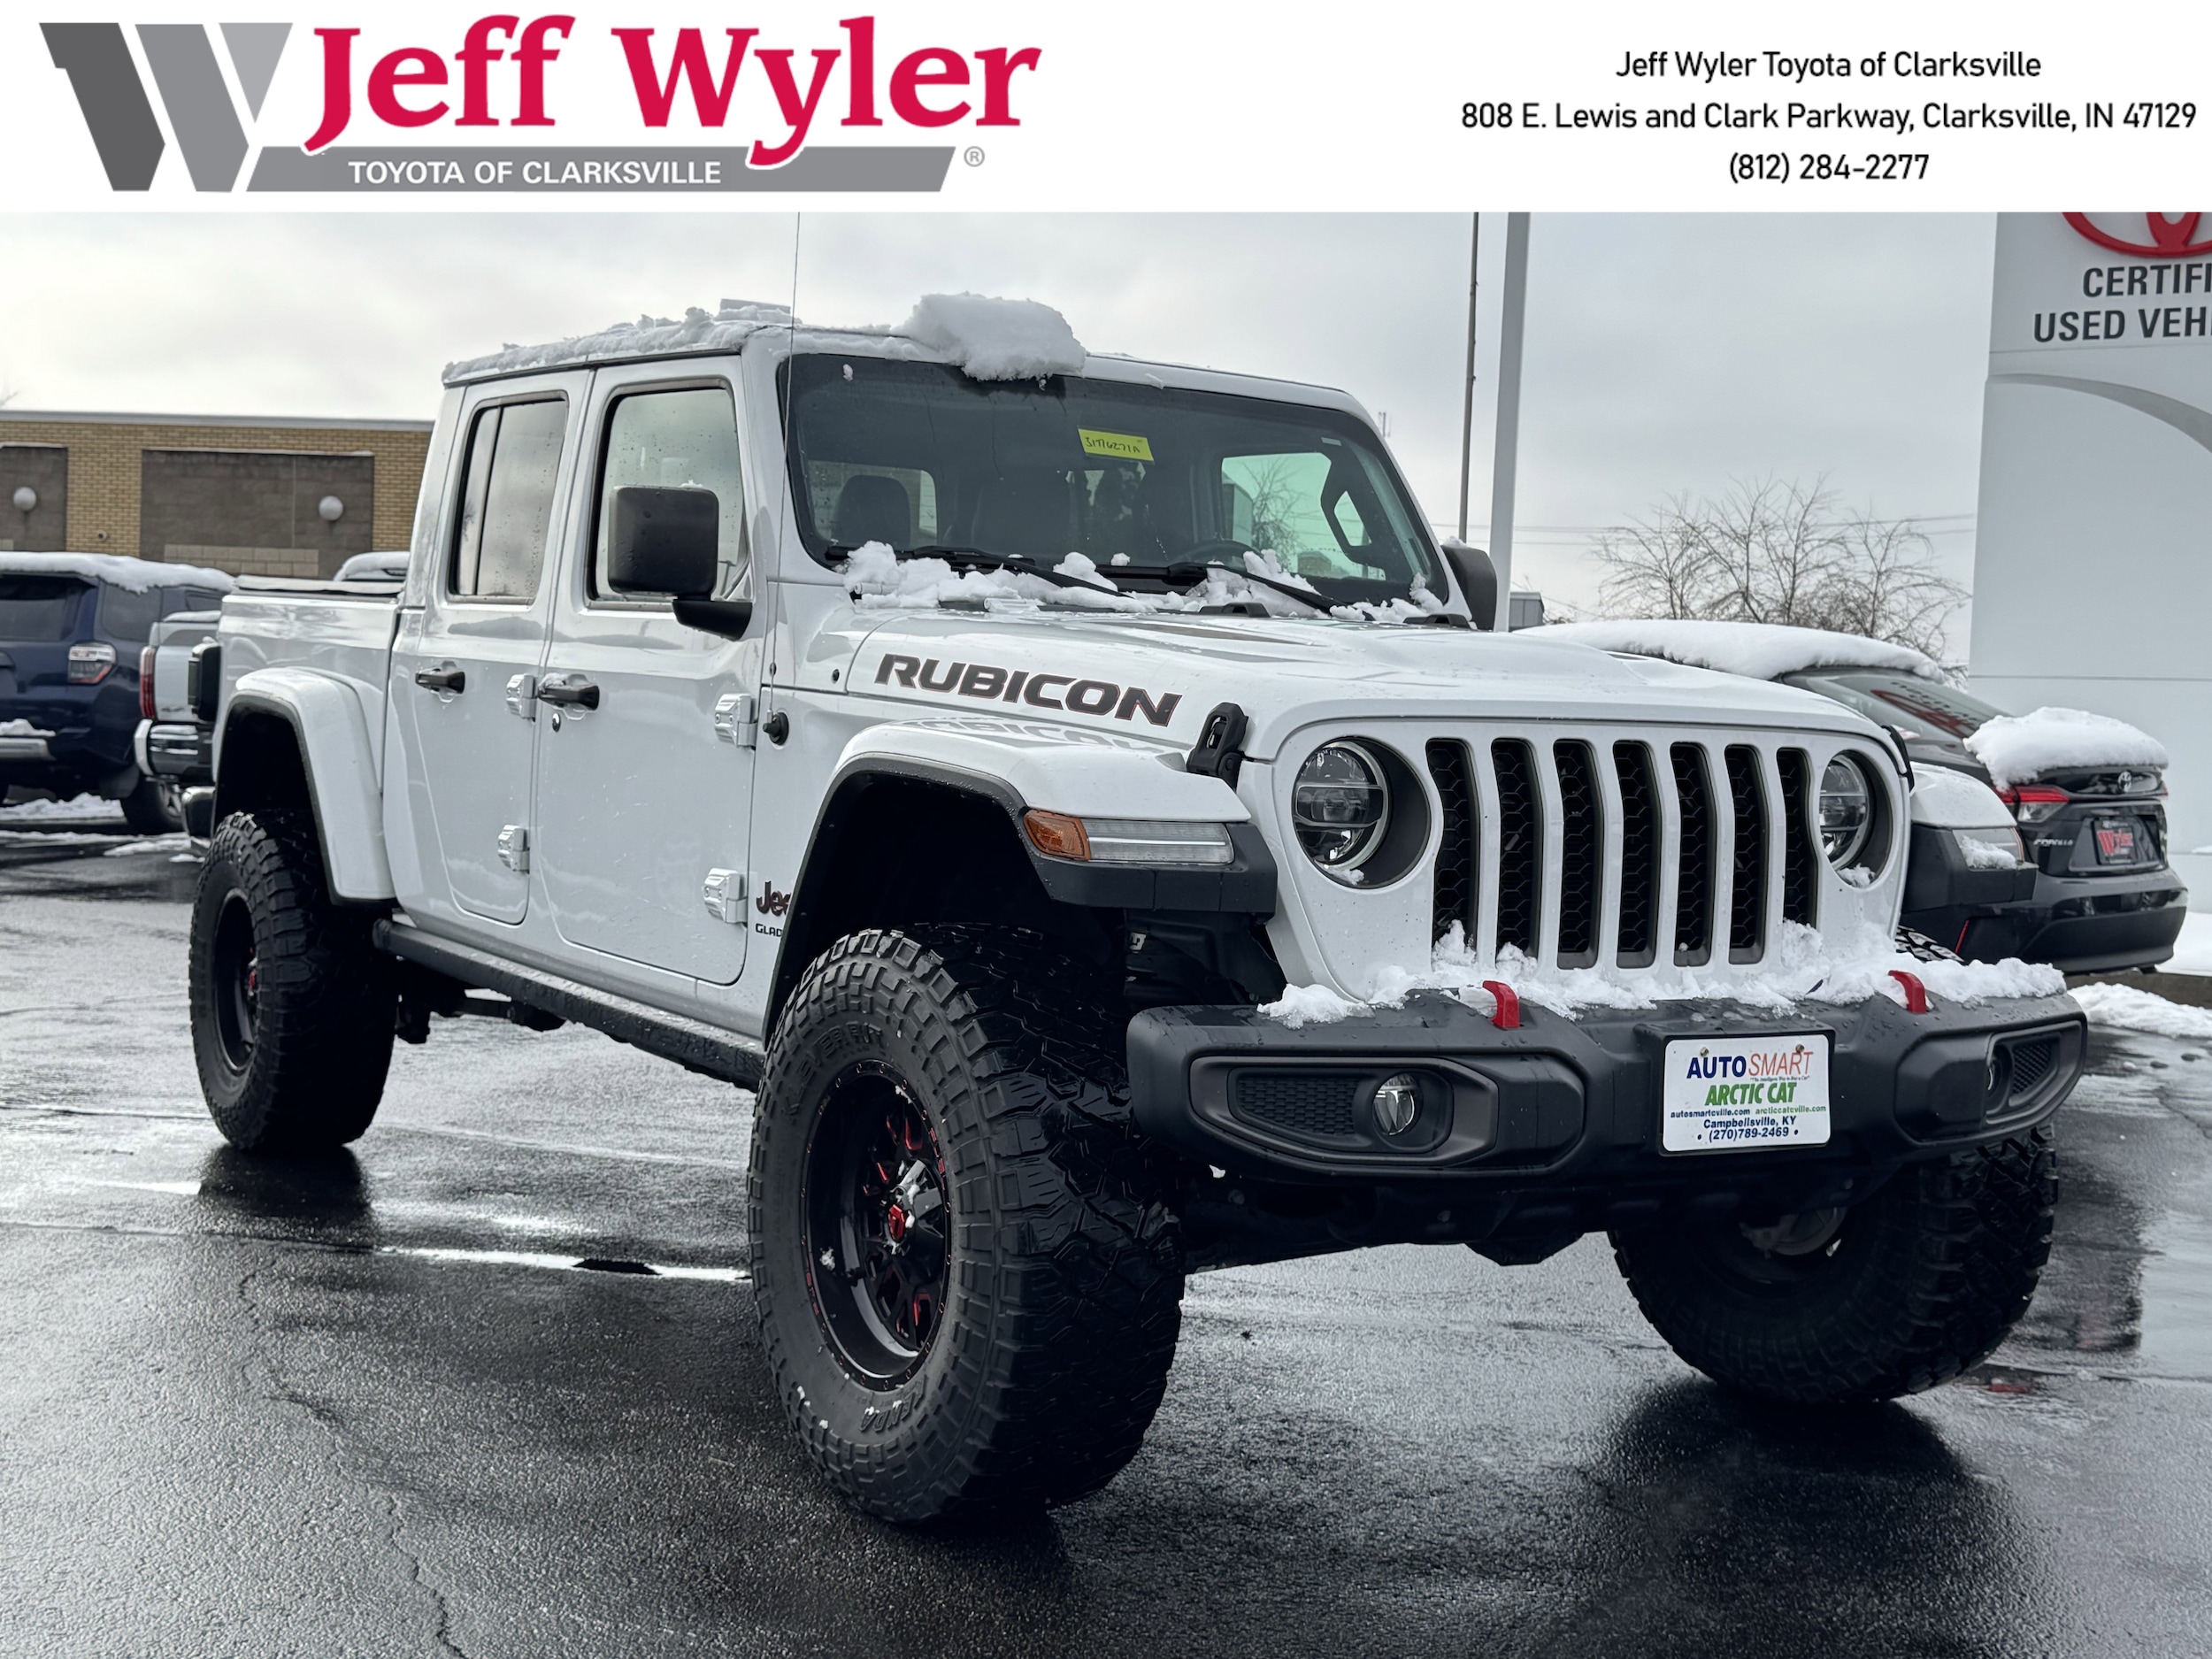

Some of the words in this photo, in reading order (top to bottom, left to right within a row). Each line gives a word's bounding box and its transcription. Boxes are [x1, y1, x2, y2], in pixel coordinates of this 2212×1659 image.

[2034, 310, 2125, 342] USED
[2138, 306, 2212, 338] VEH
[874, 653, 1183, 727] RUBICON
[1705, 1083, 1764, 1106] ARCTIC
[1767, 1082, 1798, 1104] CAT
[1703, 1117, 1779, 1131] Campbellsville,
[1782, 1115, 1798, 1125] KY
[1709, 1128, 1790, 1143] (270)789-2469
